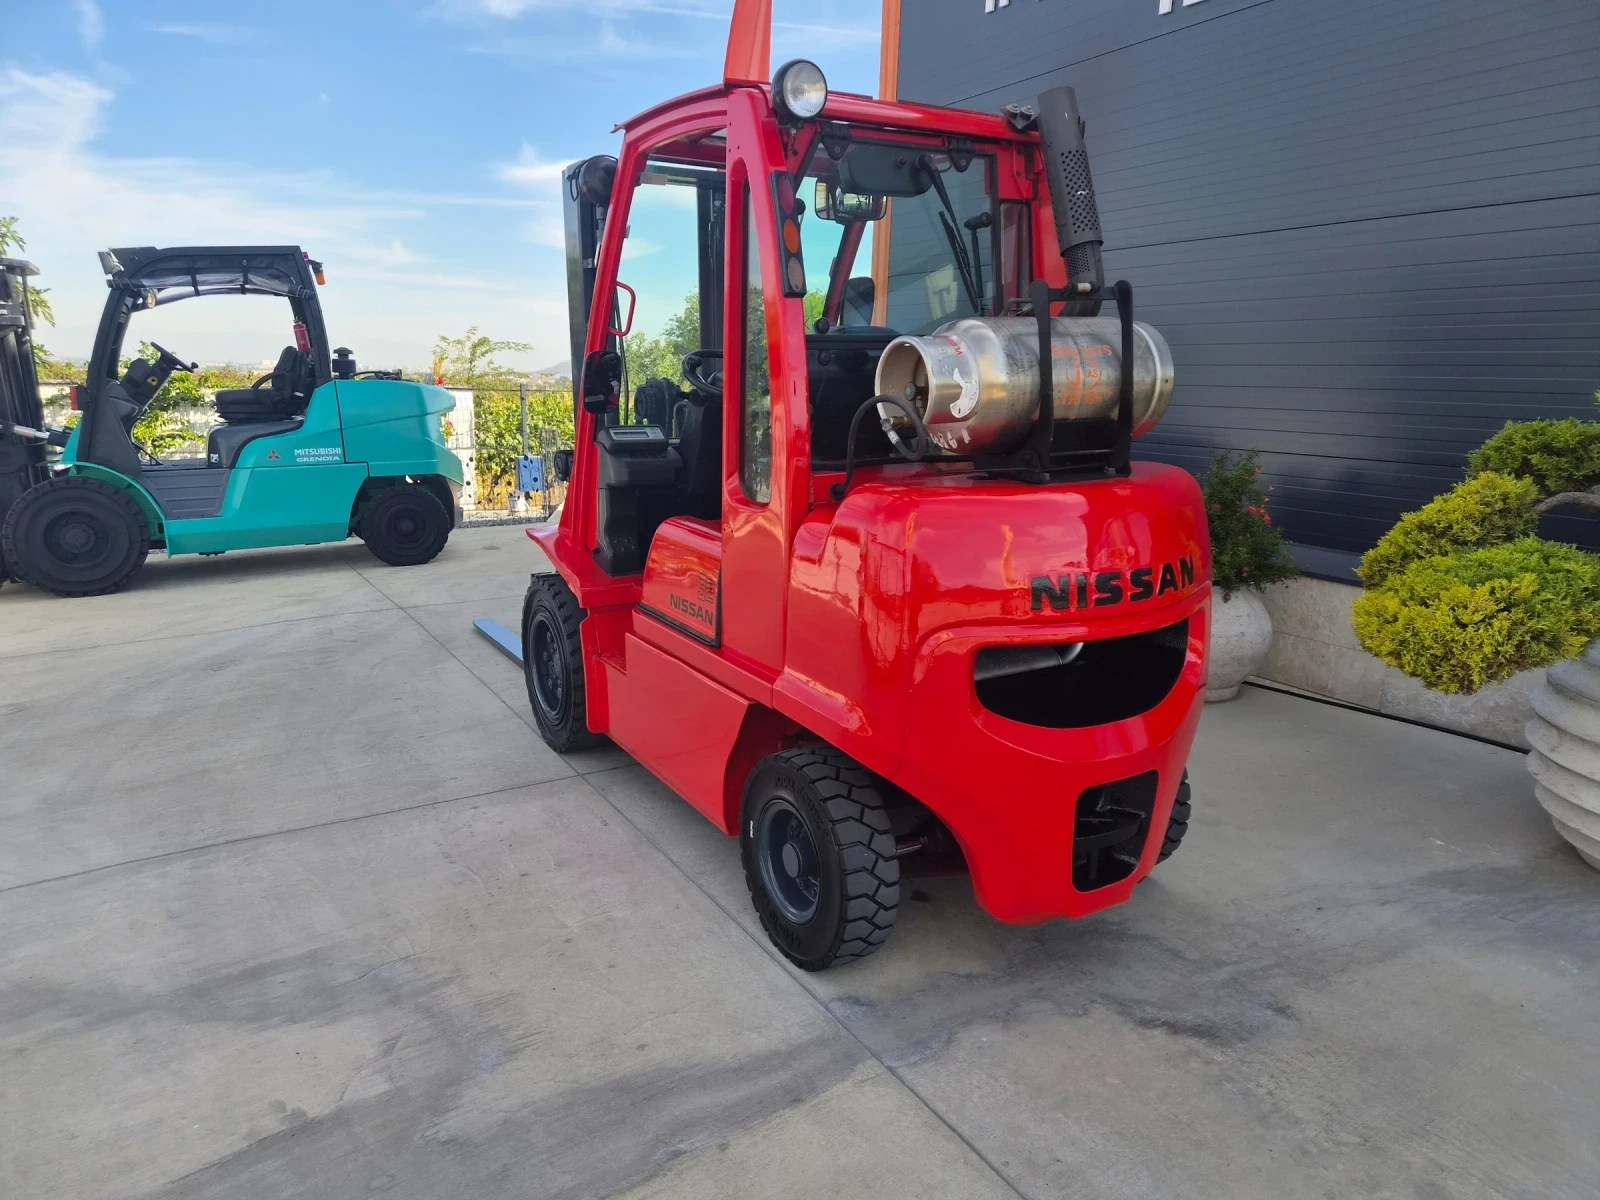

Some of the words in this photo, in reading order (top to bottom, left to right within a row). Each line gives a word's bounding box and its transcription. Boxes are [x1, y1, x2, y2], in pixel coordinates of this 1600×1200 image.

[294, 447, 341, 455] MITSUBISHI
[1030, 554, 1195, 612] NISSAN
[669, 592, 714, 627] NISSAN
